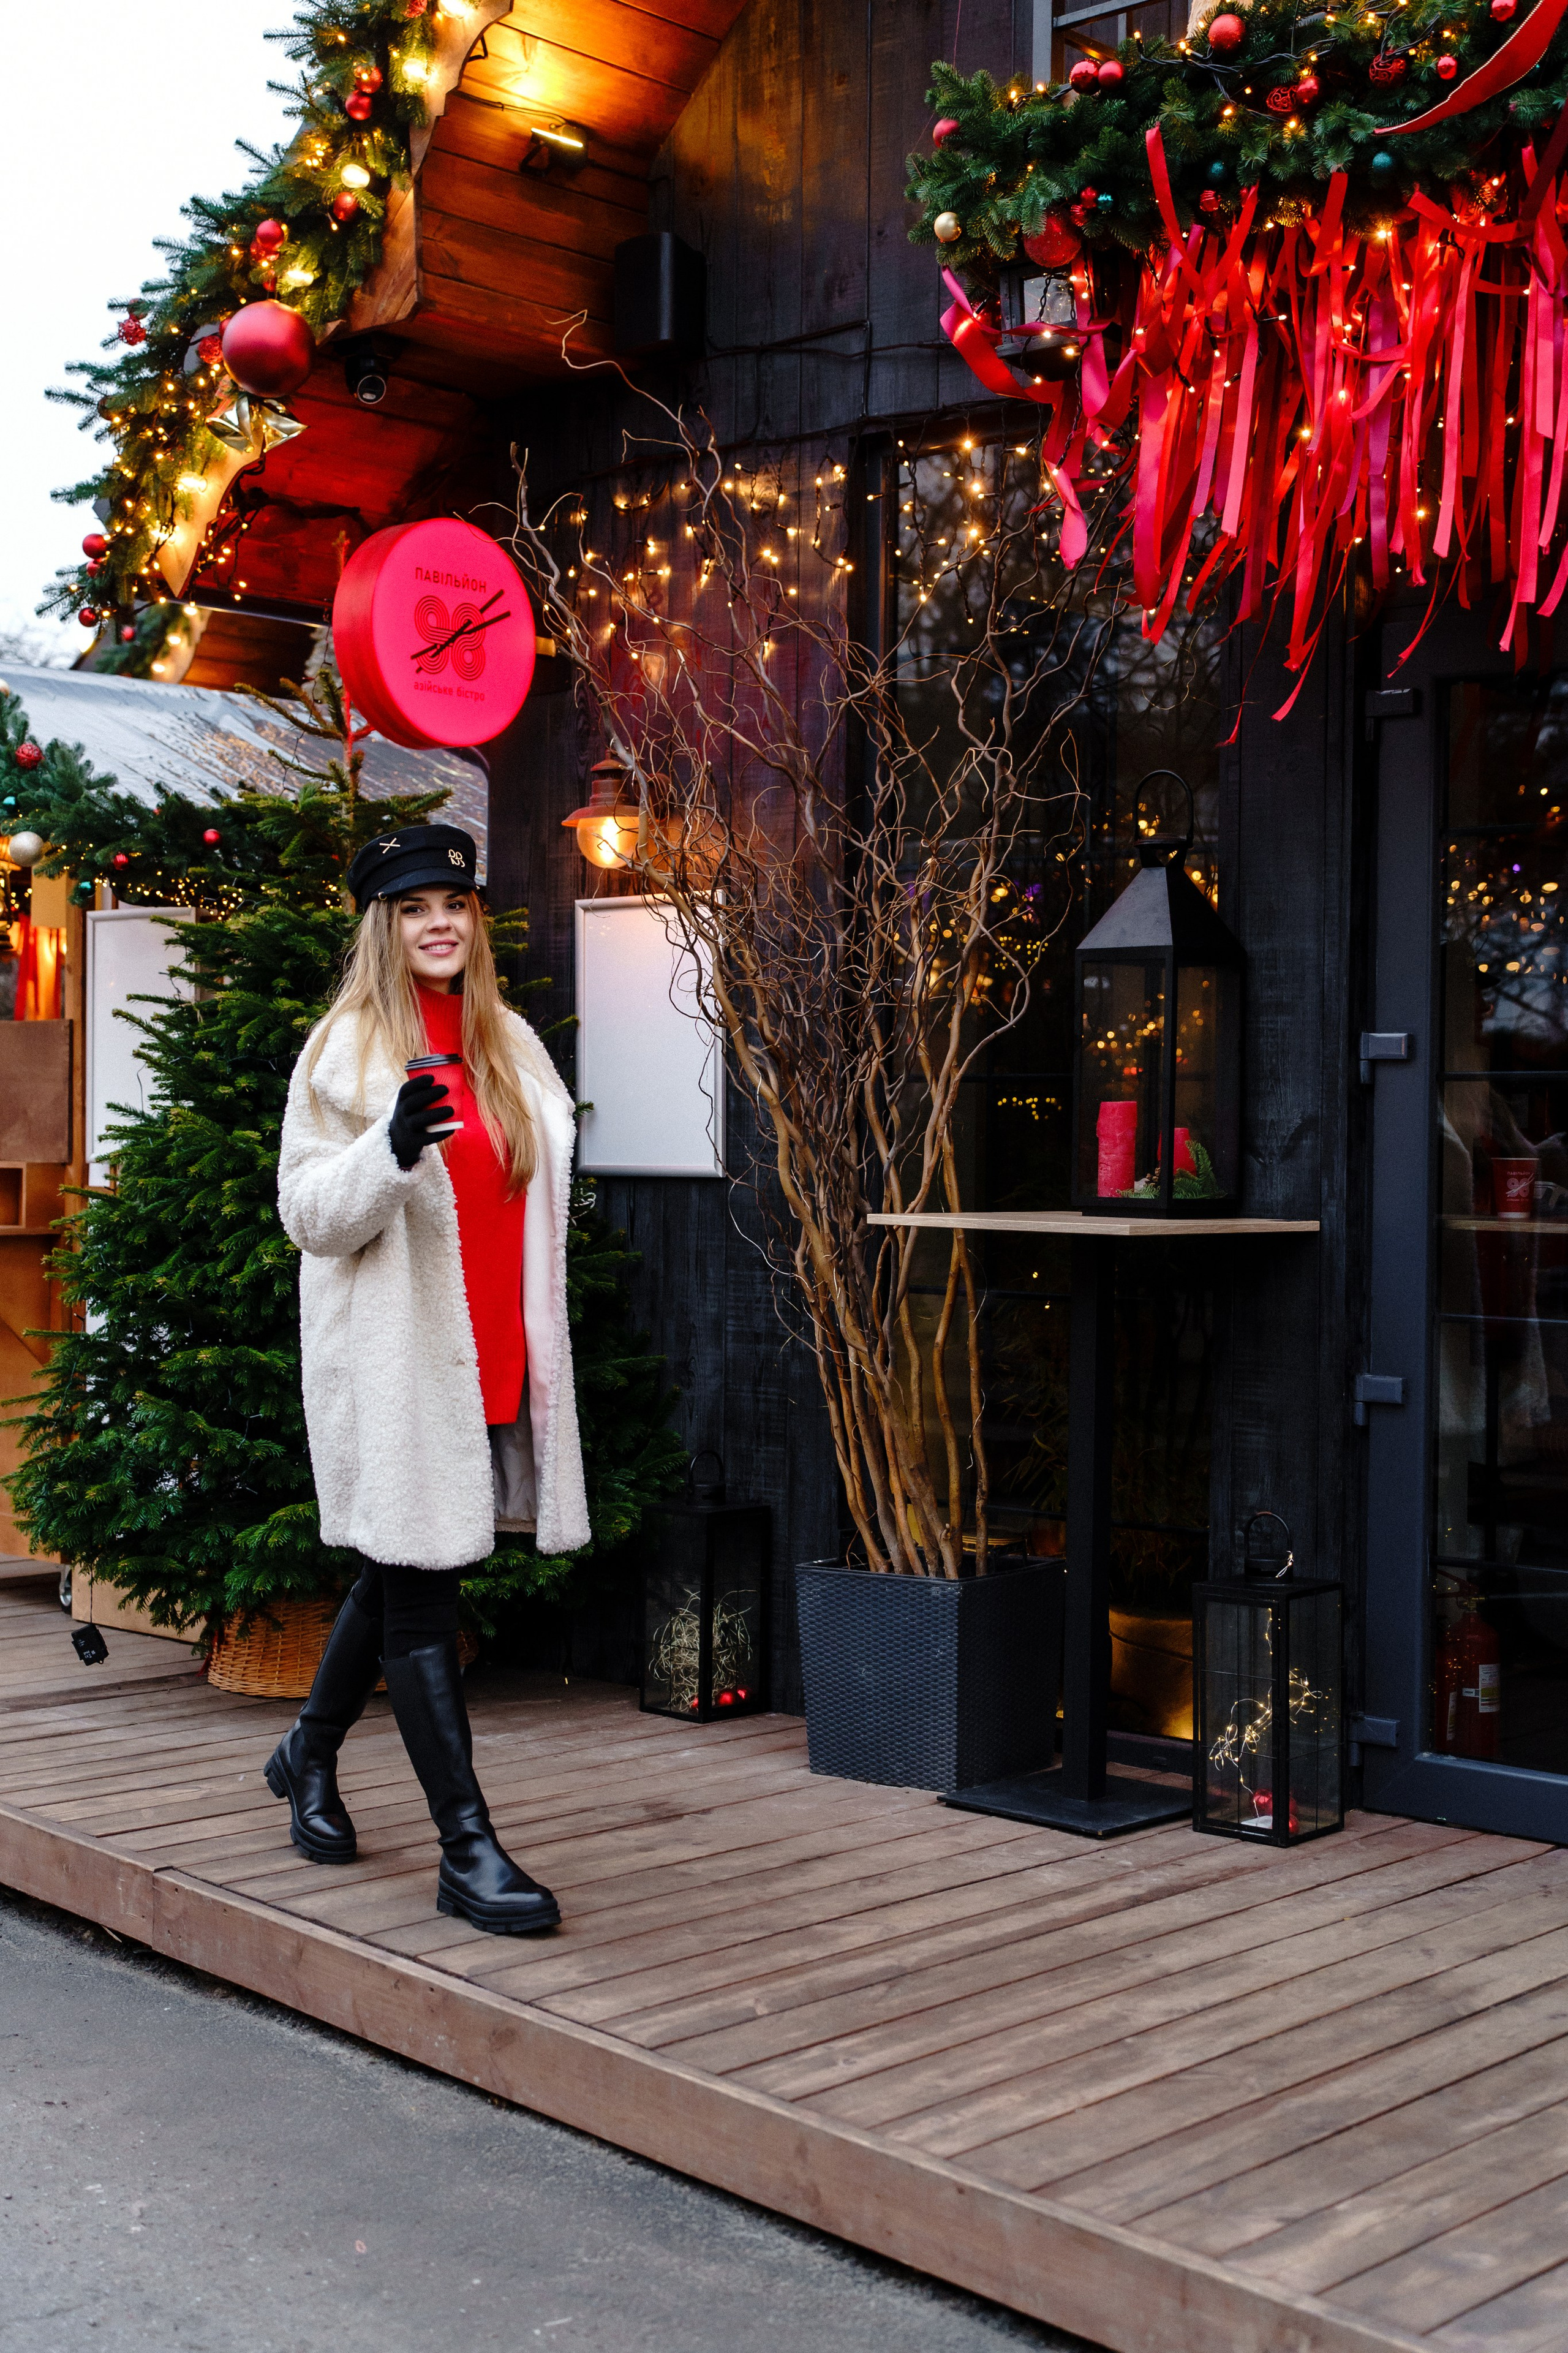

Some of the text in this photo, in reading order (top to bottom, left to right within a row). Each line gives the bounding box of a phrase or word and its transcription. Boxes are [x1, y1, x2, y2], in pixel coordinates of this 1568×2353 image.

[415, 567, 486, 593] ПАВІЛЬЙОН
[414, 681, 484, 702] азійське бістро
